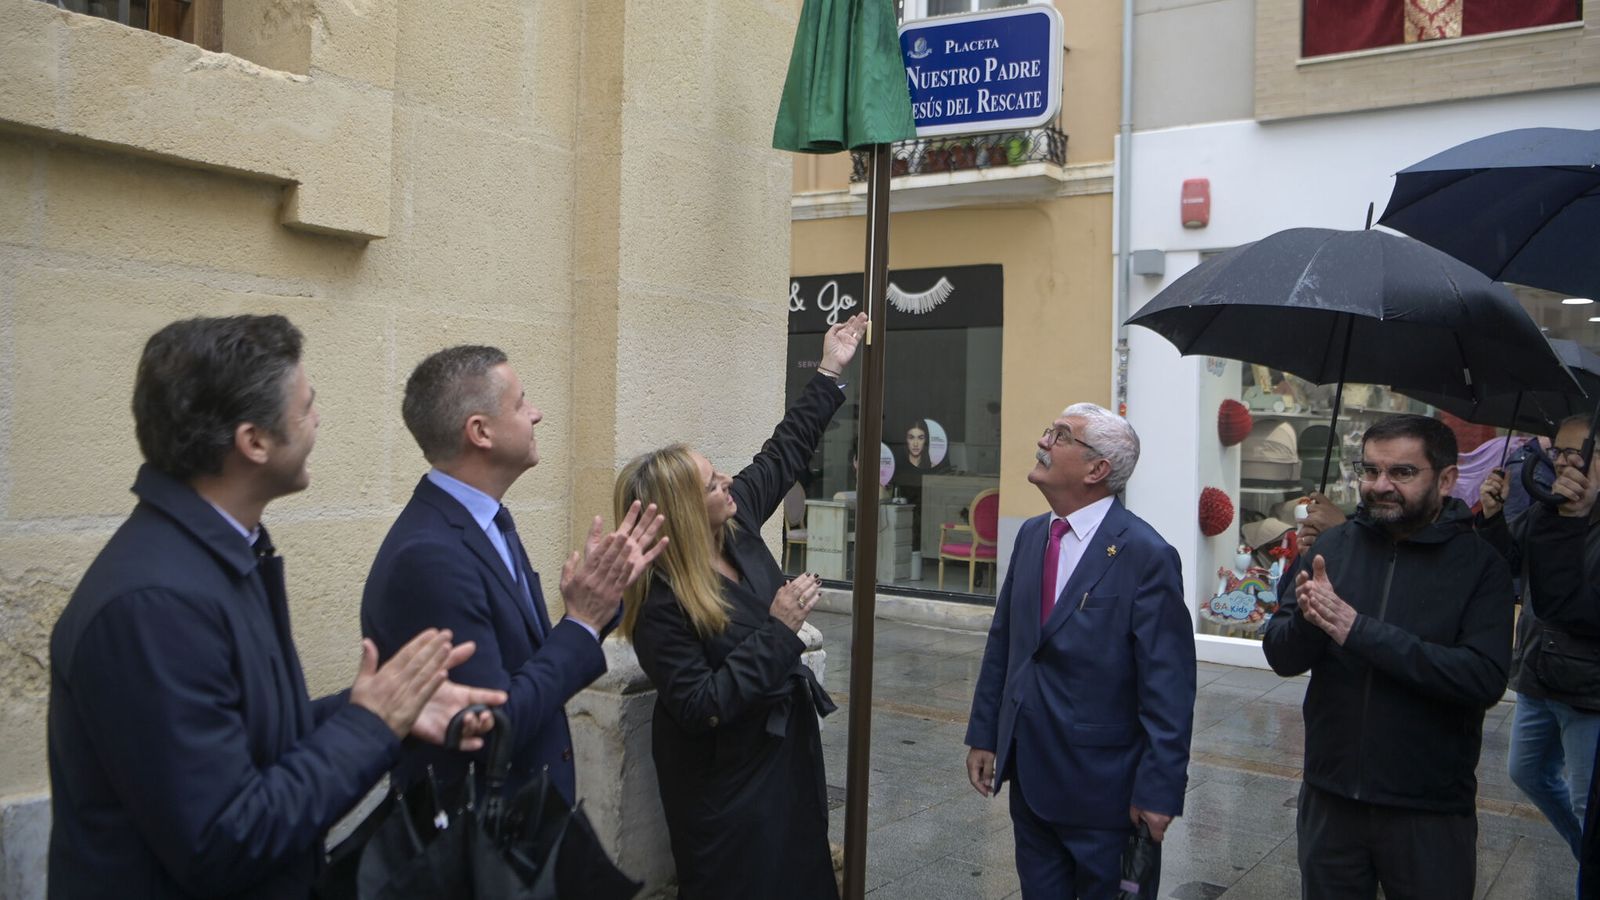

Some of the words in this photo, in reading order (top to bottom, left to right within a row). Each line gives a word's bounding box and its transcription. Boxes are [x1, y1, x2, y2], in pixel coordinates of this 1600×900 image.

[944, 38, 999, 54] PLACETA
[906, 66, 980, 90] NUESTRO
[984, 57, 1040, 82] PADRE
[912, 96, 942, 120] ESÚS
[946, 98, 972, 116] DEL
[977, 88, 1041, 114] RESCATE
[789, 281, 806, 312] &
[817, 281, 857, 326] Go
